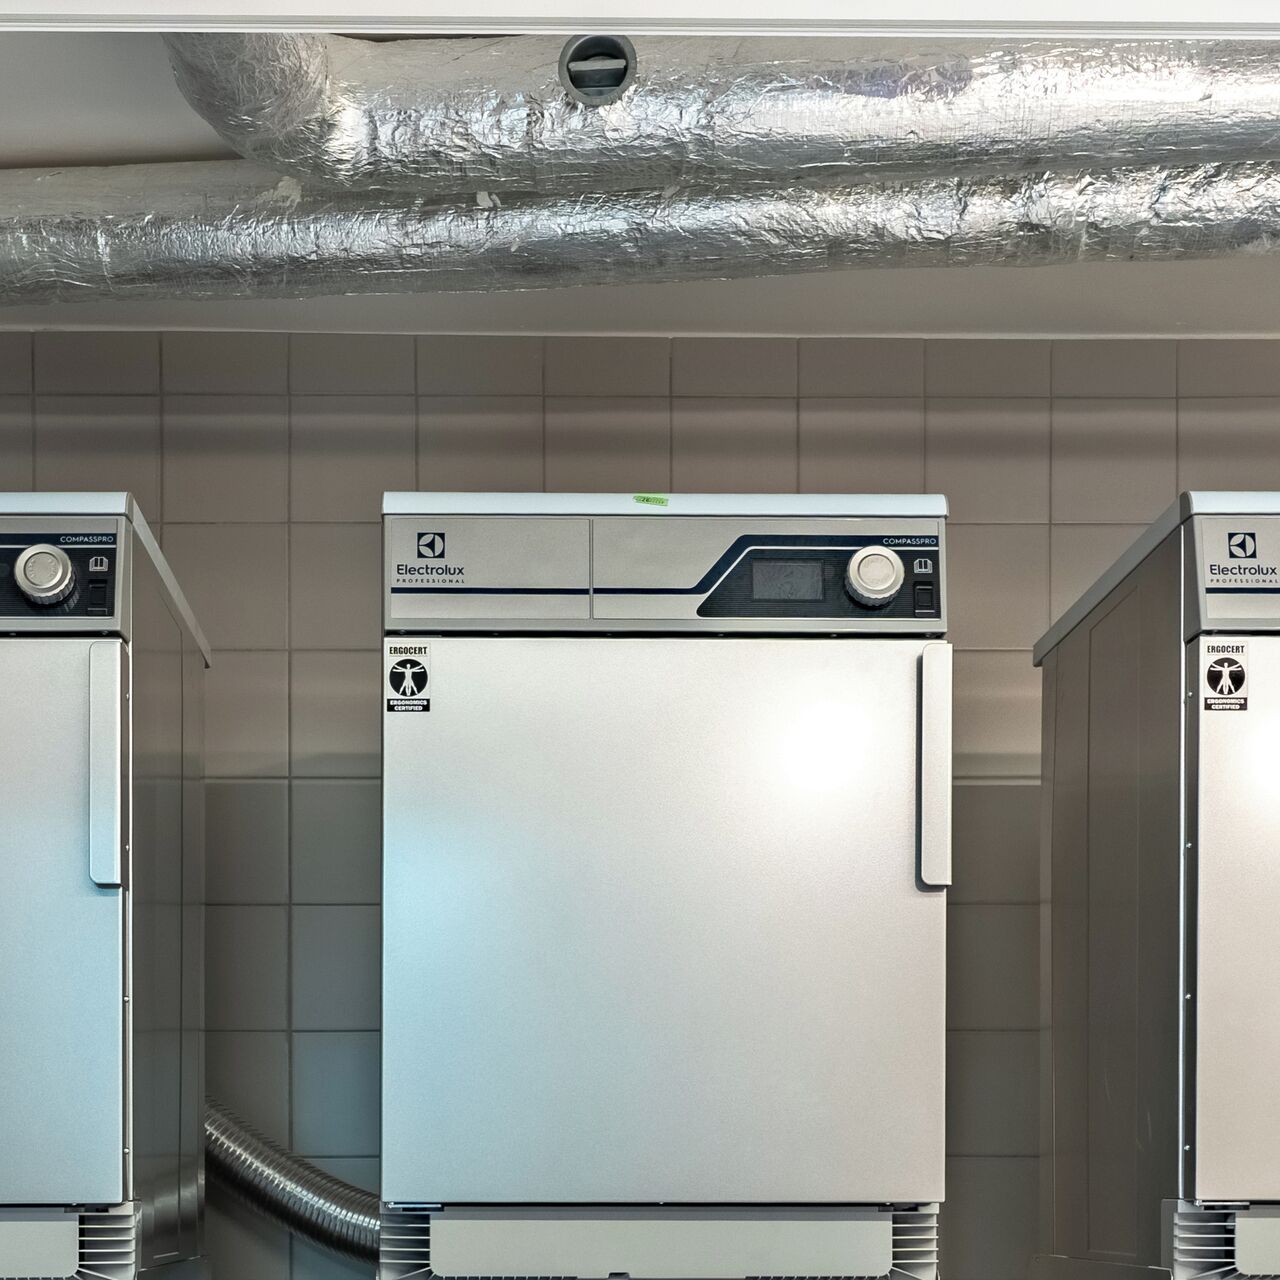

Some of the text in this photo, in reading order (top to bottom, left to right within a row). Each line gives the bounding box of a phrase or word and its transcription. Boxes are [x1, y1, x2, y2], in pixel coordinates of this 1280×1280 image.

[397, 563, 465, 577] Electrolux
[1209, 563, 1278, 577] Electrolux
[389, 646, 428, 655] ERGOCERT
[1207, 645, 1245, 654] ERGOCERT
